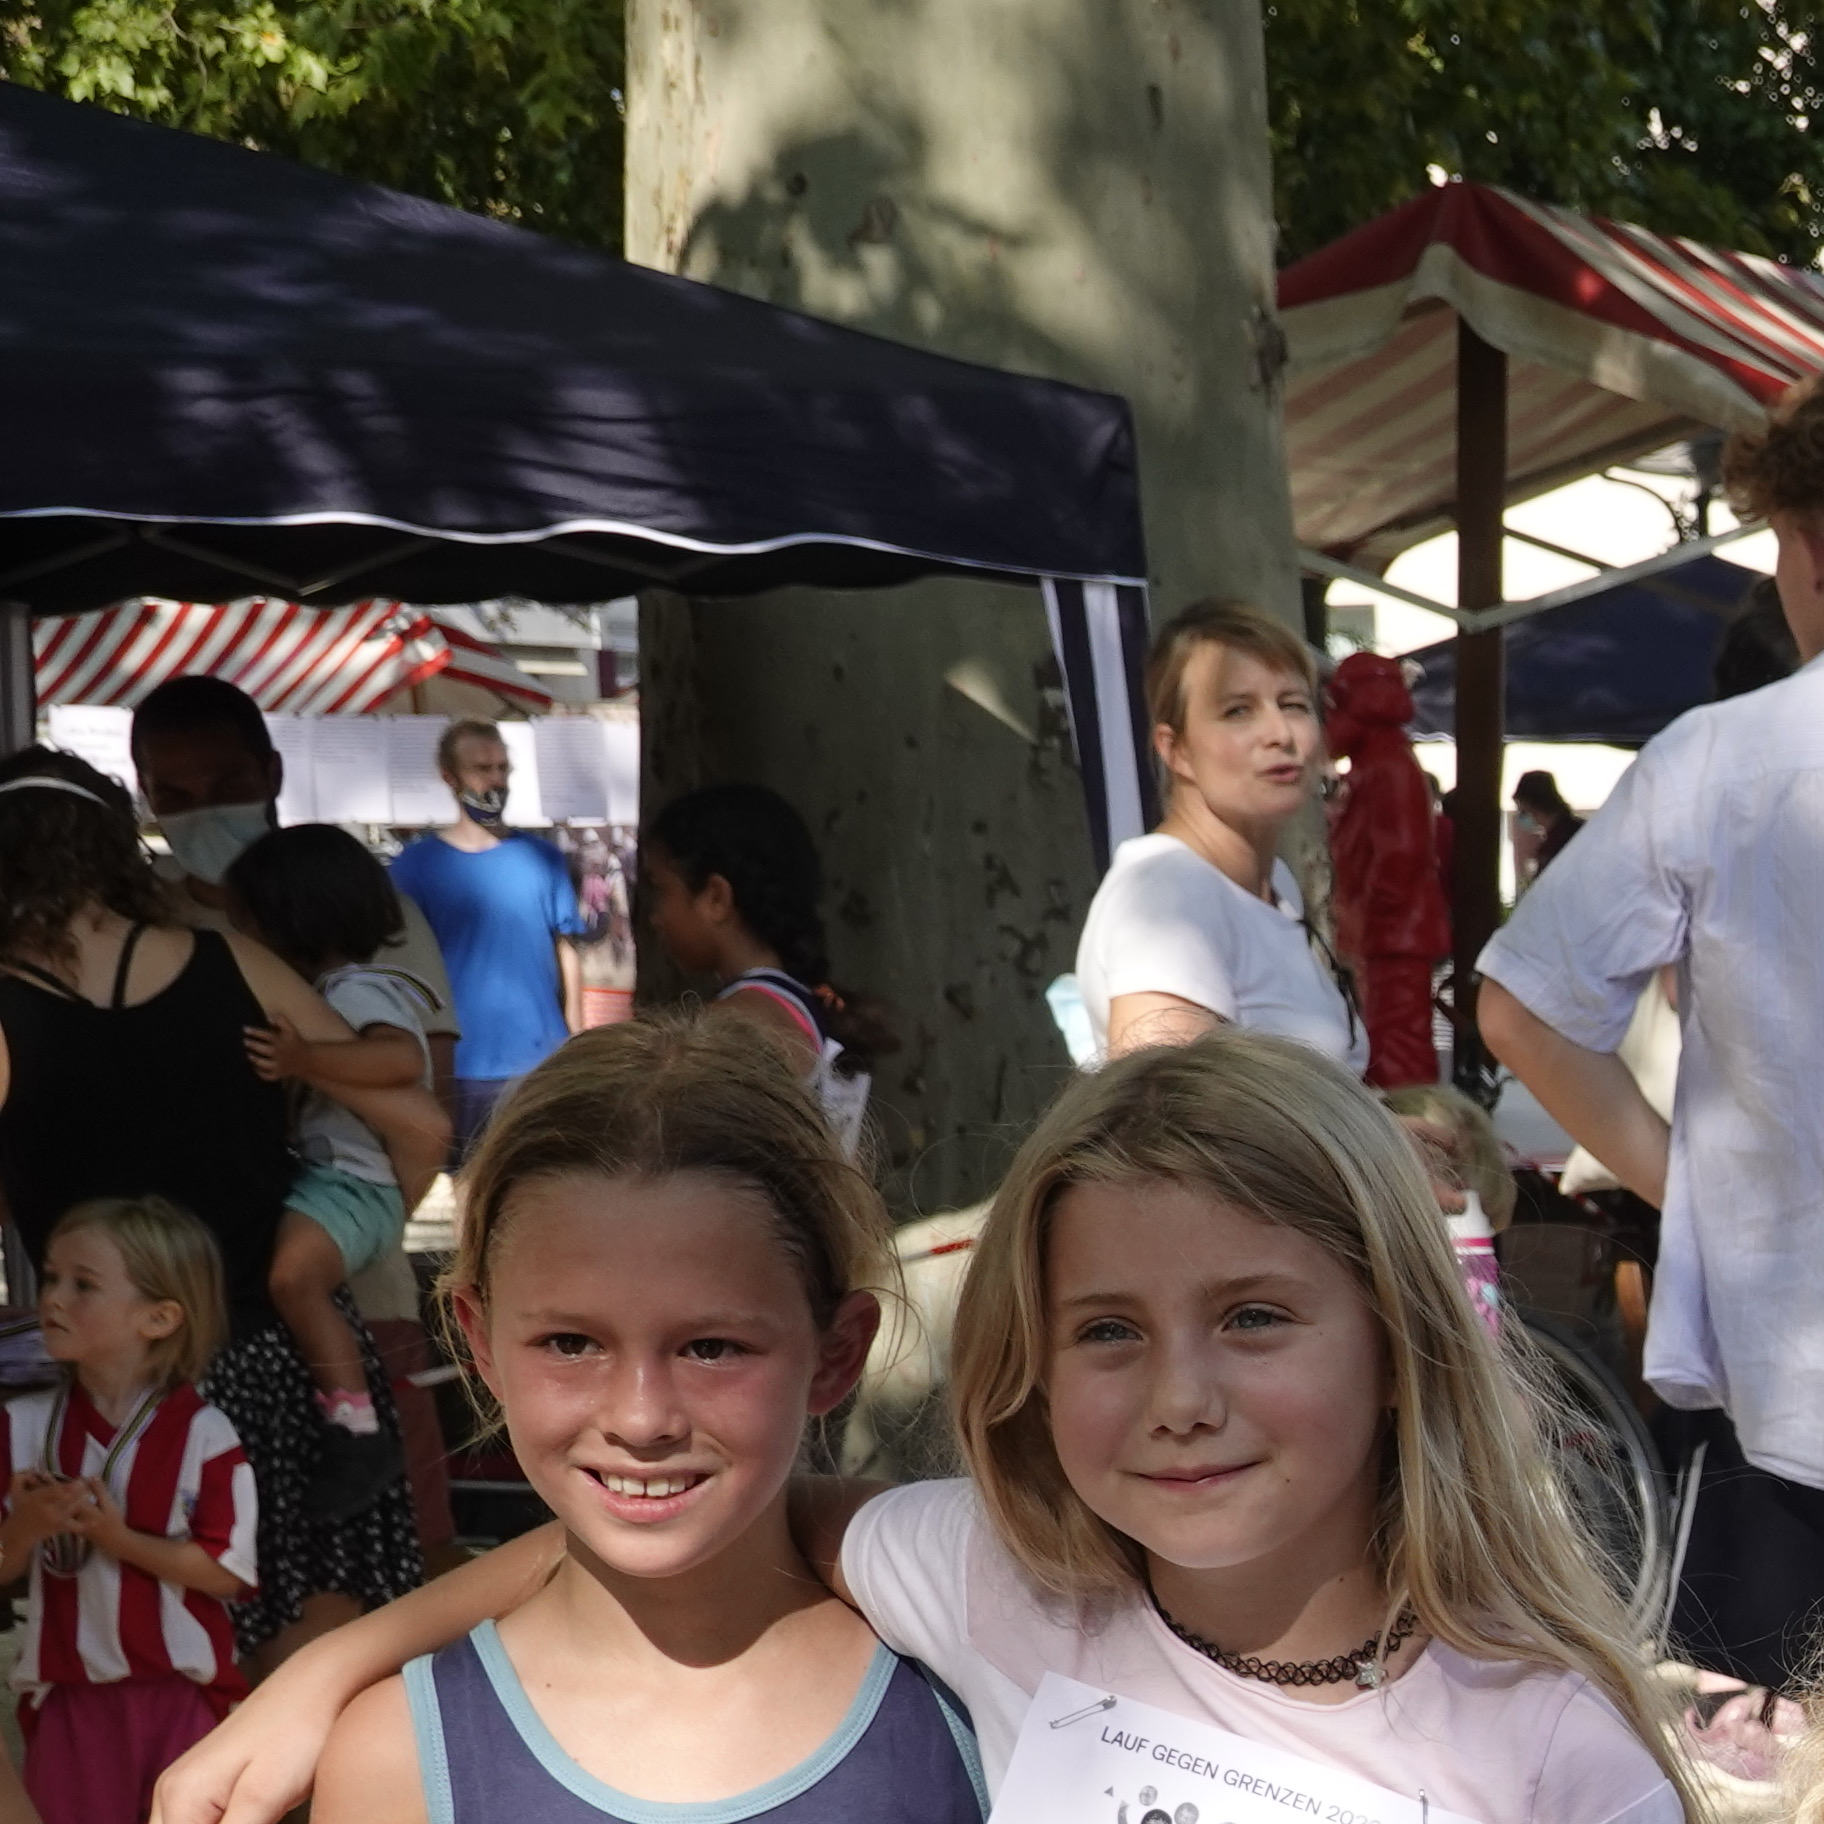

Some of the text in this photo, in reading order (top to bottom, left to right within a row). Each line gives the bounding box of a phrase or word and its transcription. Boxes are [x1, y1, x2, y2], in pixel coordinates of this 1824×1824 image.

[1101, 1725, 1150, 1755] LAUF
[1152, 1744, 1220, 1780] GEGEN
[1222, 1768, 1322, 1816] GRENZEN
